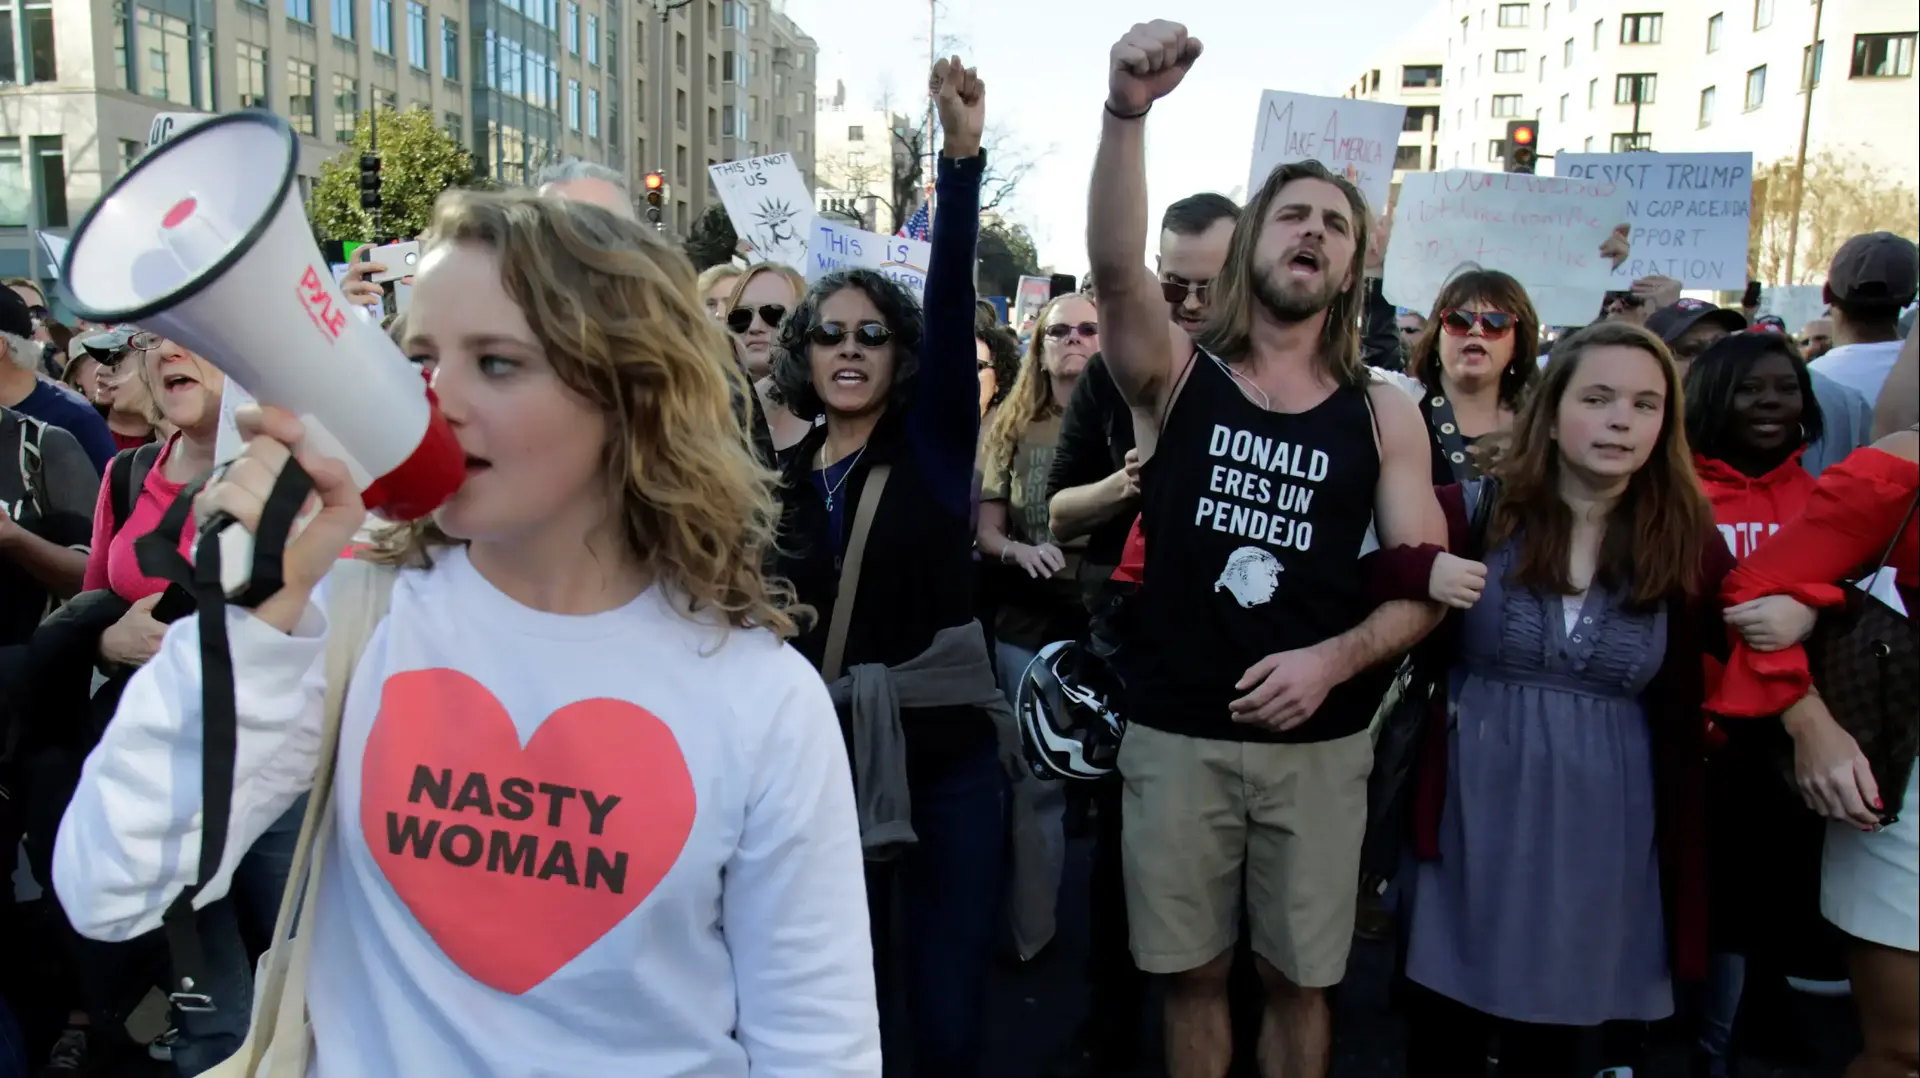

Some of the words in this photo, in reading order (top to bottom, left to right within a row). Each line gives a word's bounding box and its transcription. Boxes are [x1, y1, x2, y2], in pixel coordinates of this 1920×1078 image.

[1261, 99, 1317, 158] MAKE
[713, 162, 746, 177] THIS
[747, 159, 762, 170] IS
[763, 154, 787, 168] NOT
[743, 172, 768, 187] US
[1666, 163, 1745, 190] TRUMP
[1646, 200, 1684, 218] GOP
[1632, 228, 1707, 248] PPORT
[299, 263, 346, 338] PYLE
[1208, 423, 1330, 482] DONALD
[1209, 464, 1272, 504] ERES
[1277, 483, 1314, 515] UN
[1194, 496, 1313, 552] PENDEJO
[407, 763, 623, 836] NASTY
[386, 811, 630, 895] WOMAN
